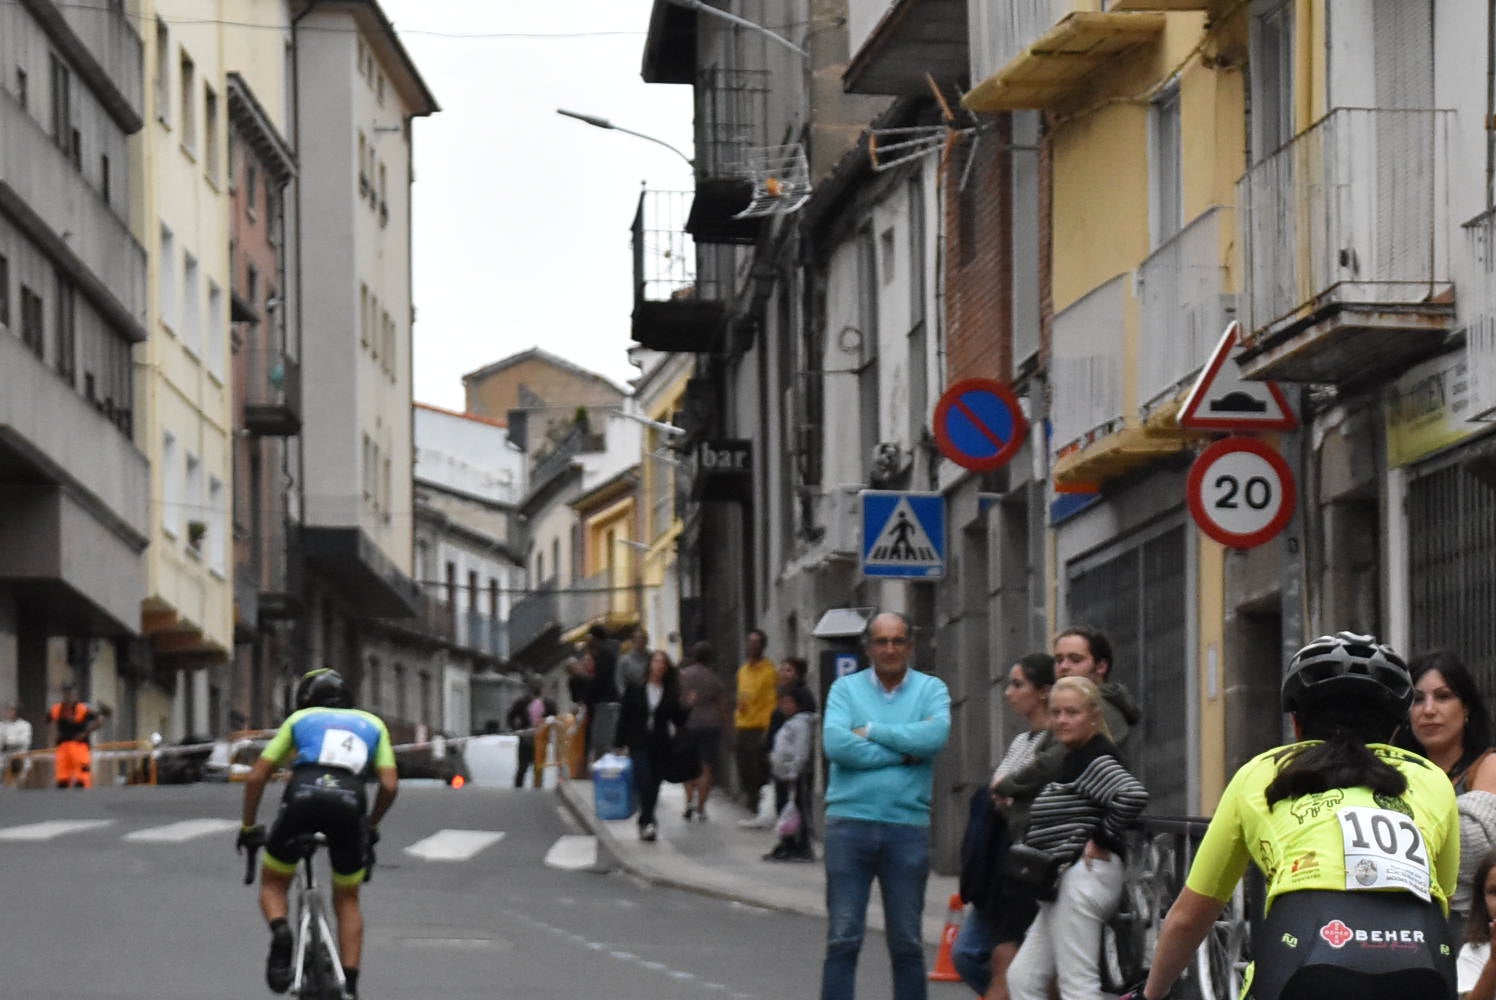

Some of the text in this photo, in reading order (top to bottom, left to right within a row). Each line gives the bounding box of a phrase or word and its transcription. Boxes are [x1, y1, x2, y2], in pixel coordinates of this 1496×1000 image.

[701, 440, 747, 468] bar
[1215, 474, 1272, 510] 20
[836, 657, 858, 678] P
[1344, 810, 1426, 866] 102
[1355, 929, 1425, 943] BEHER
